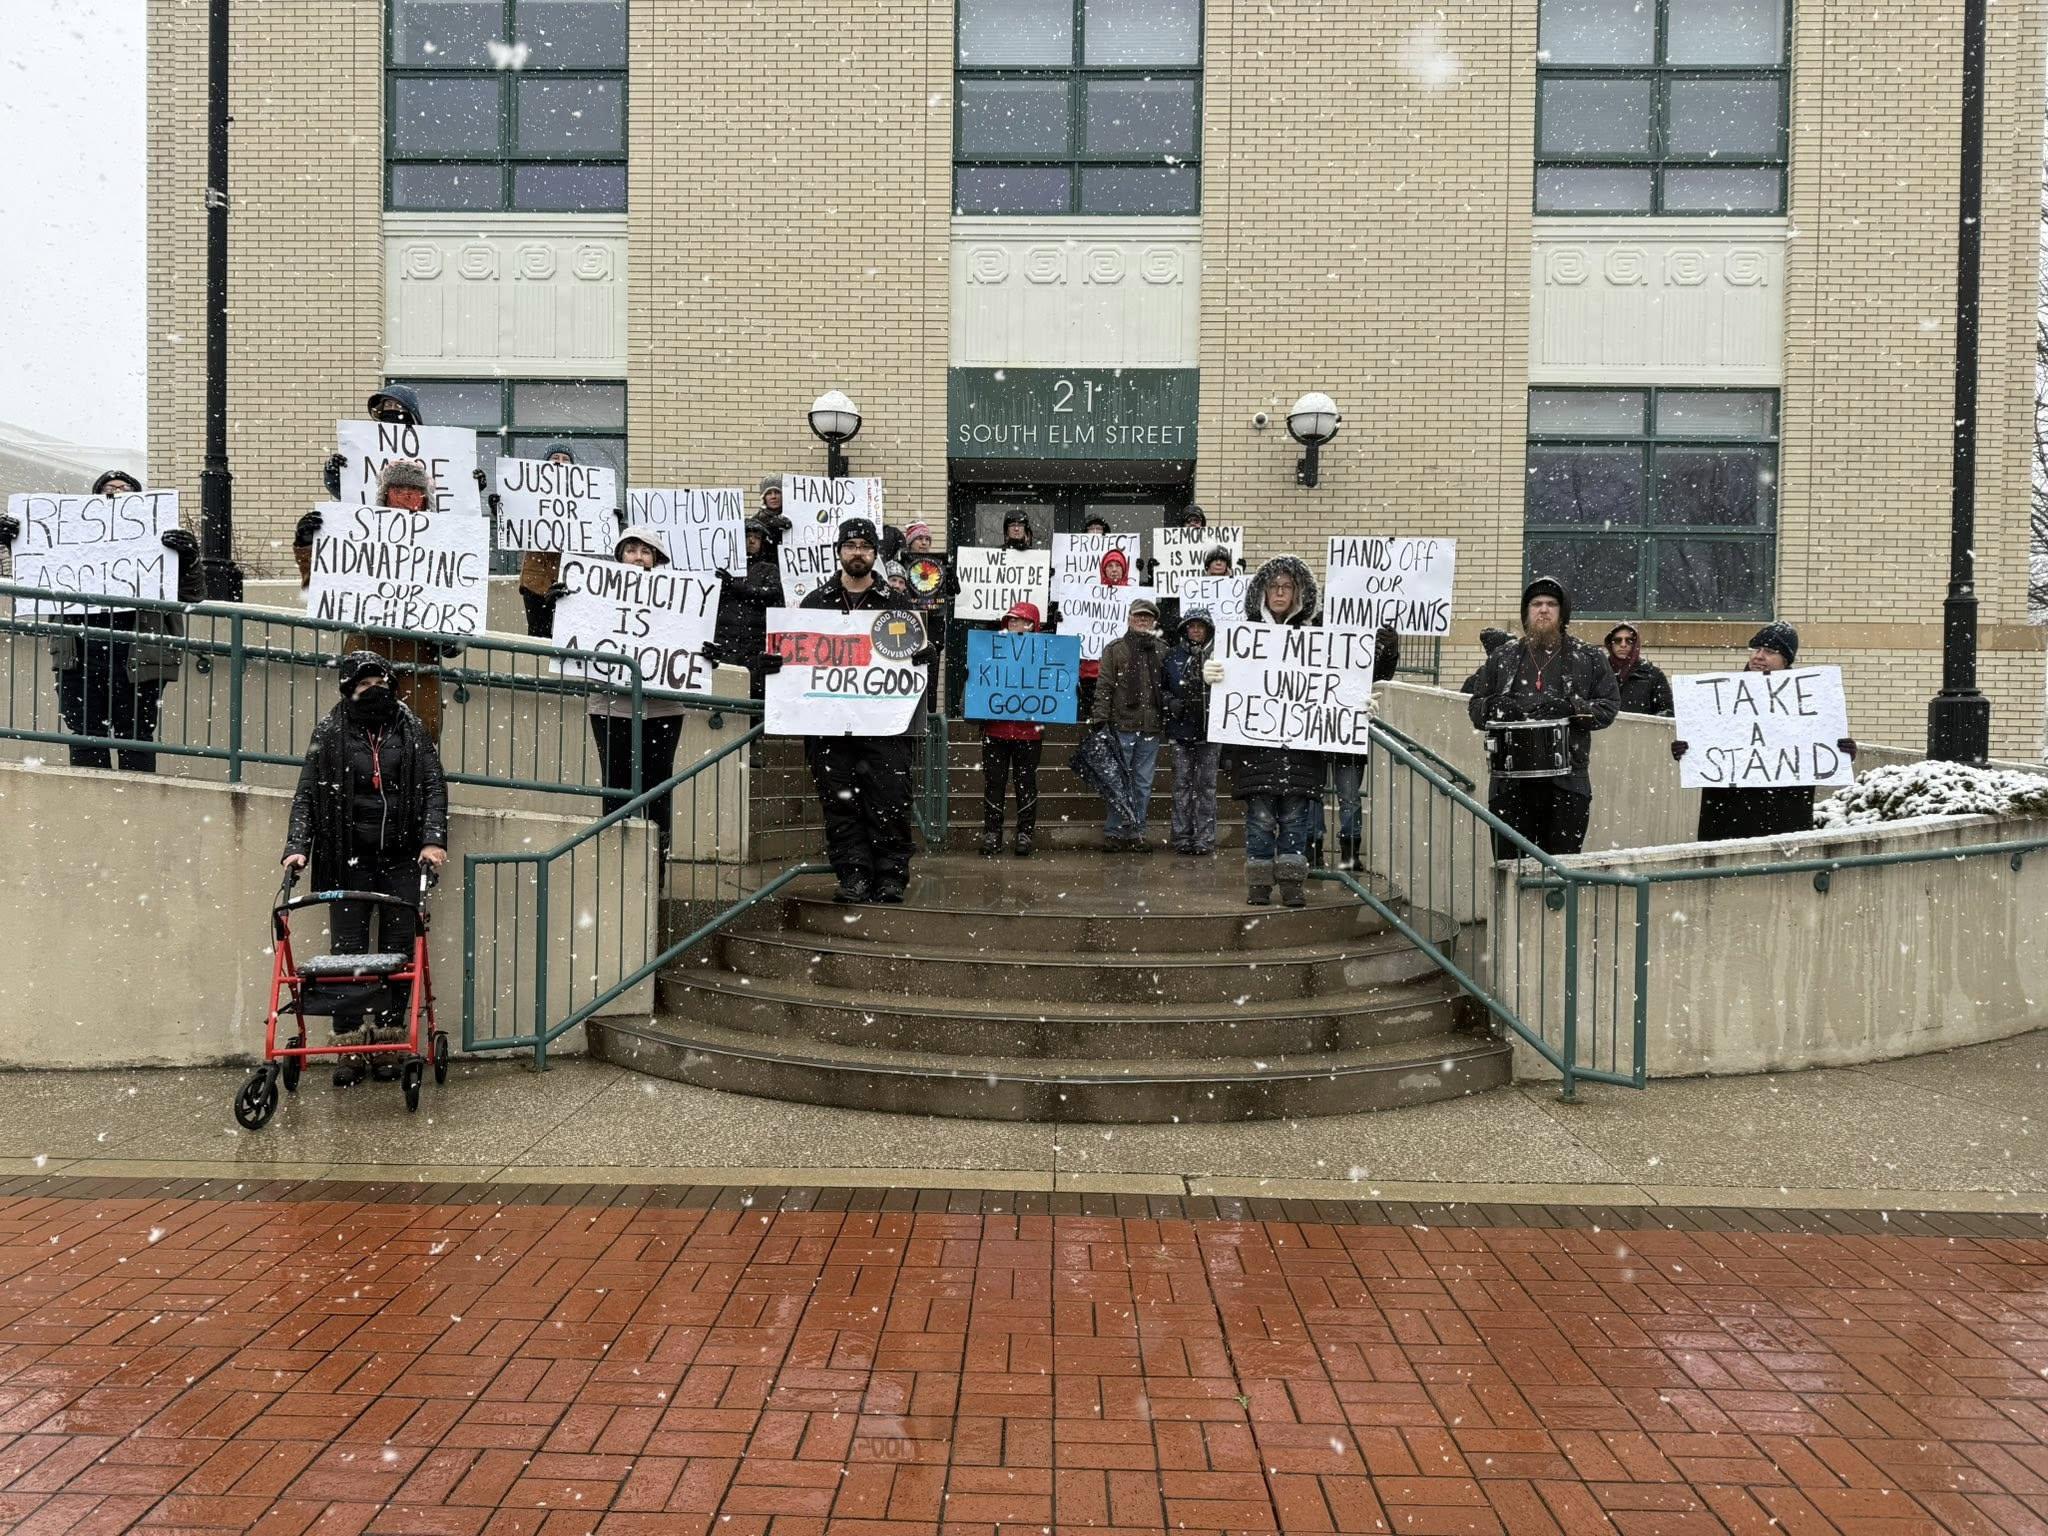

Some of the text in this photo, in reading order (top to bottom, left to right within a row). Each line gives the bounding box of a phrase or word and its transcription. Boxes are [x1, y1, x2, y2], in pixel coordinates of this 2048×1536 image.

[1052, 379, 1094, 413] 21
[377, 423, 420, 458] NO
[959, 424, 1186, 444] SOUTH ELM STREET
[504, 461, 600, 499] JUSTICE
[793, 477, 856, 506] HANDS
[22, 493, 174, 549] RESIST
[539, 498, 578, 520] FOR
[631, 490, 742, 526] NO HUMAN
[349, 507, 429, 546] STOP
[506, 519, 596, 553] NICOLE
[1163, 527, 1240, 545] DEMOCRACY
[986, 551, 1007, 566] WE
[1070, 534, 1137, 552] PROTECT
[1330, 538, 1394, 571] HANDS
[313, 535, 479, 589] KIDNAPPING
[959, 566, 991, 584] WILL
[996, 566, 1024, 585] NOT
[1028, 565, 1044, 586] BE
[14, 553, 166, 612] FASCISM
[377, 582, 426, 604] OUR
[563, 561, 716, 618] COMPLICITY
[1091, 586, 1121, 603] OUR
[1183, 579, 1225, 600] GET
[1366, 575, 1404, 595] OUR
[317, 589, 478, 634] NEIGHBORS
[973, 588, 1033, 611] SILENT
[1063, 599, 1130, 623] COMMUNI
[1330, 597, 1450, 633] IMMIGRANTS
[613, 607, 652, 638] IS
[1091, 621, 1118, 637] OUR
[565, 635, 703, 690] A CHOICE
[815, 636, 860, 667] OUT
[992, 634, 1066, 667] EVIL
[1226, 626, 1374, 670] ICE MELTS
[811, 666, 926, 696] FOR GOOD
[979, 664, 1071, 693] KILLED
[1264, 670, 1353, 707] UNDER
[988, 692, 1058, 715] GOOD
[1695, 674, 1821, 716] TAKE
[1222, 692, 1368, 746] RESISTANCE
[1750, 722, 1766, 747] A
[1700, 742, 1839, 783] STAND
